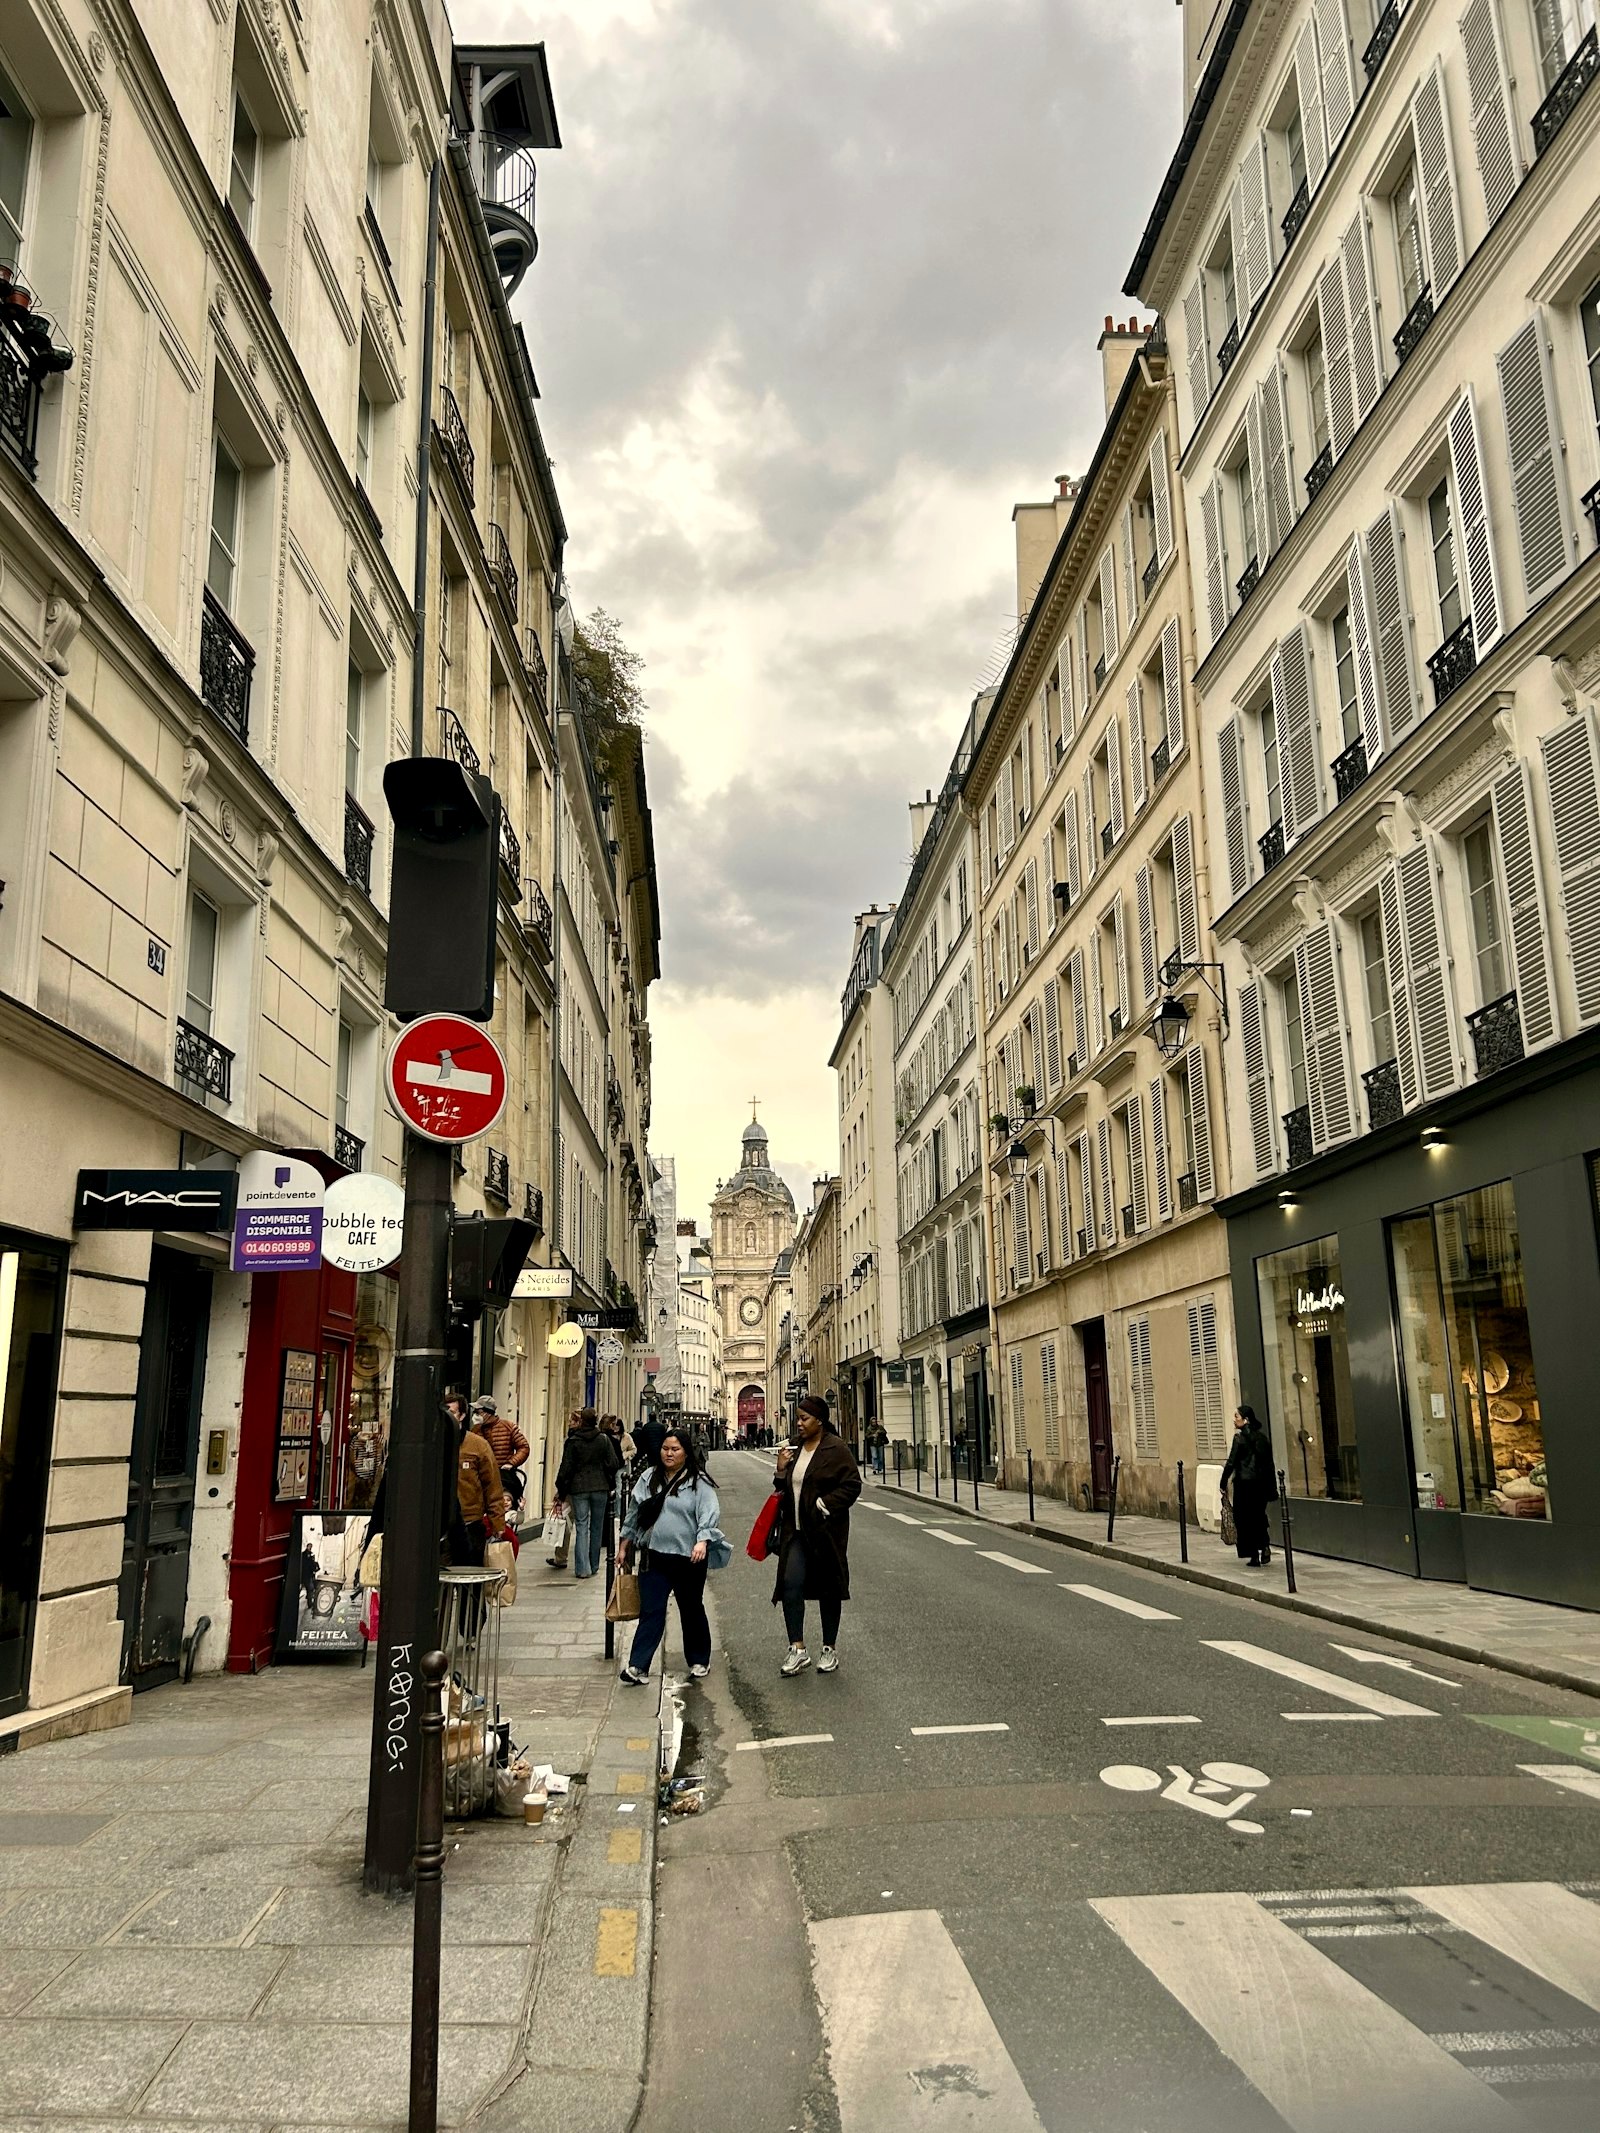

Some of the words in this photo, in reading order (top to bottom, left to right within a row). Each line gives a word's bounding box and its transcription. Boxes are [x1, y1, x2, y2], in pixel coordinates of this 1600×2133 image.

[149, 942, 163, 973] 34
[246, 1191, 316, 1201] pointdevente
[250, 1214, 310, 1225] COMMERCE
[246, 1225, 312, 1236] DISPONIBLE
[348, 1231, 377, 1245] CAFE
[336, 1256, 356, 1269] FEI
[358, 1257, 385, 1270] TEA
[527, 1274, 570, 1284] Néréides
[577, 1313, 599, 1322] Miel
